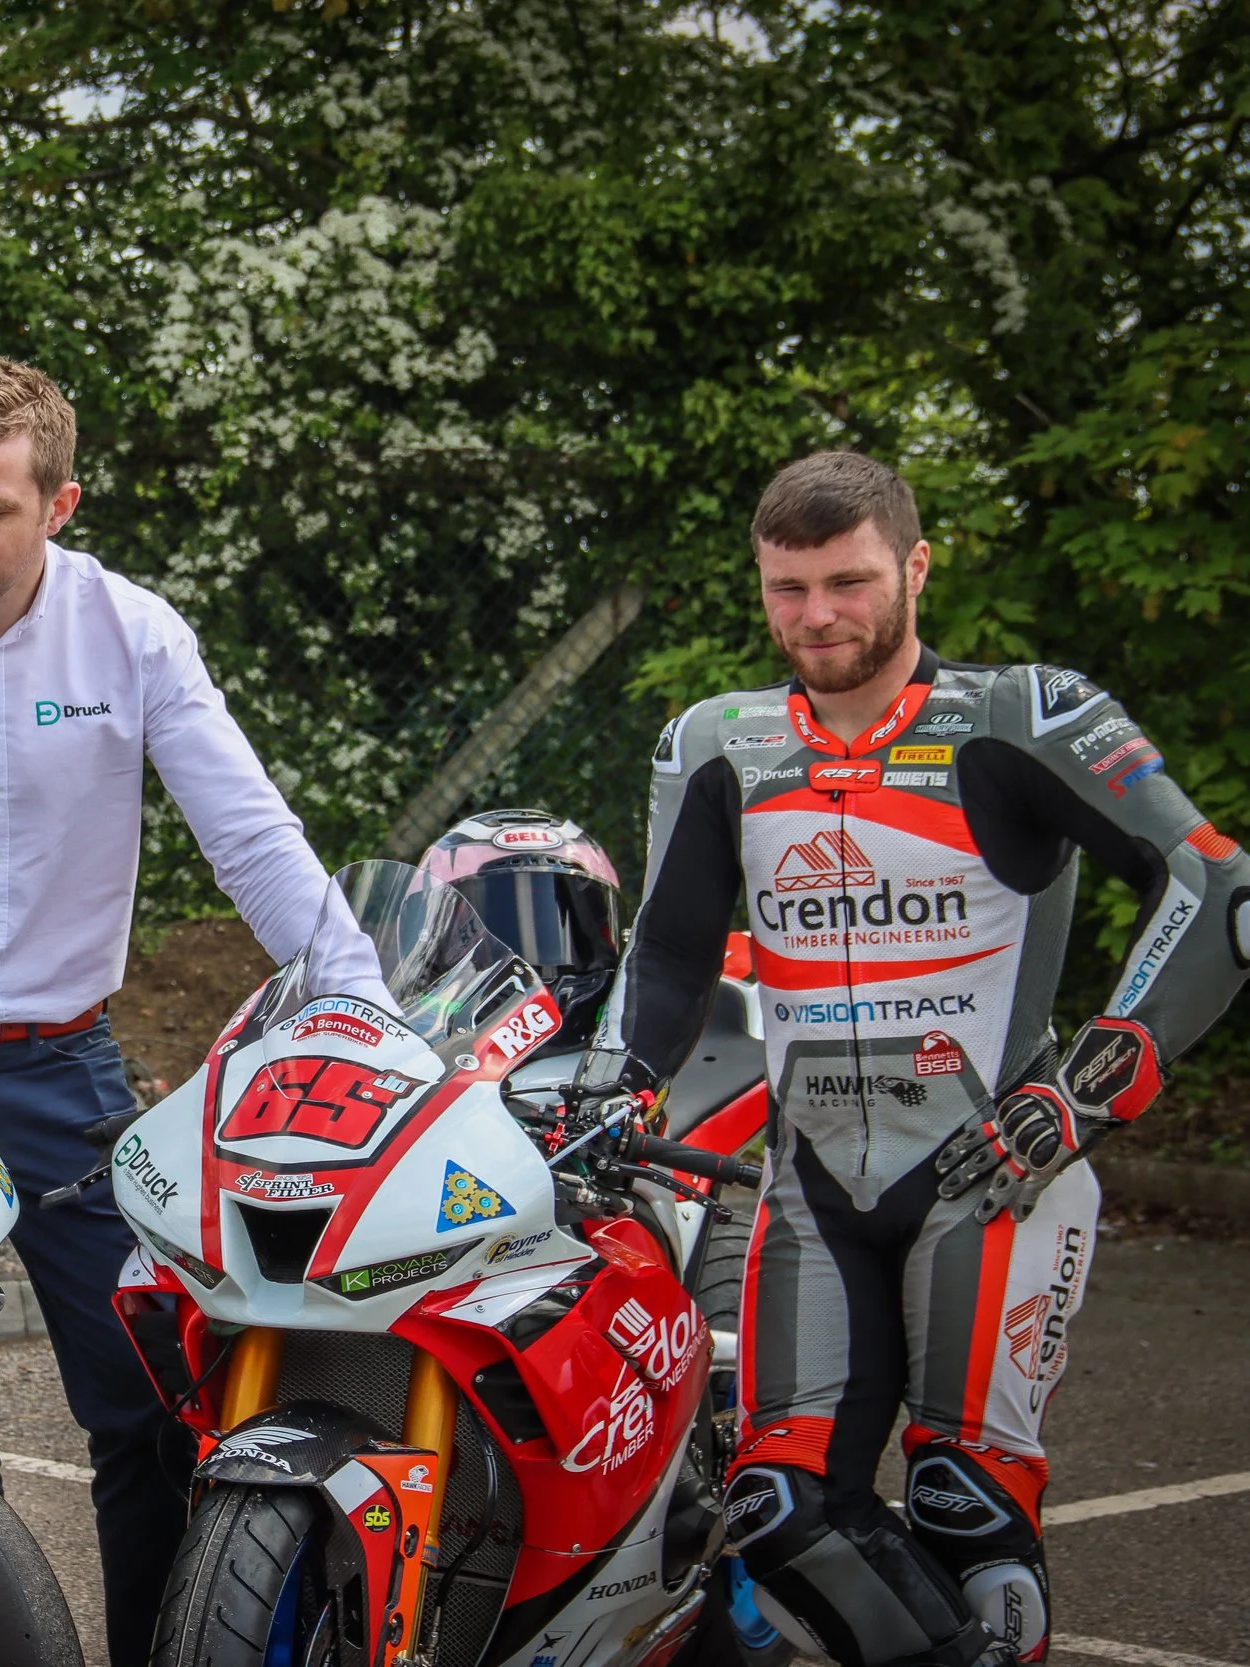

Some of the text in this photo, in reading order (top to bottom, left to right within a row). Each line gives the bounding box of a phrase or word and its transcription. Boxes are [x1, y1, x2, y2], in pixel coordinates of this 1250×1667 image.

[63, 702, 112, 718] Druck
[869, 699, 907, 745] RST
[727, 735, 787, 746] LS2
[796, 711, 828, 745] RST
[895, 749, 946, 761] PIRELLI
[762, 766, 803, 781] Druck
[813, 766, 878, 780] RST
[882, 771, 949, 787] OWENS
[504, 831, 553, 844] BELL
[906, 875, 966, 888] Since 1967
[757, 879, 967, 932] Crendon
[783, 926, 971, 949] TIMBER ENGINEERING
[296, 1000, 411, 1042] VISIONTRACK
[793, 993, 977, 1023] VISIONTRACK
[316, 1018, 378, 1044] Bennetts
[490, 1003, 555, 1060] R&G
[915, 1051, 959, 1062] Bennetts
[917, 1058, 963, 1076] BSB
[1072, 1034, 1123, 1094] RST
[221, 1057, 399, 1148] 65
[128, 1148, 179, 1209] Druck
[254, 1180, 313, 1190] SPRINT
[267, 1183, 334, 1198] FILTER
[144, 1193, 164, 1216] business
[488, 1229, 554, 1265] Paynes
[504, 1247, 537, 1262] Hinckley
[371, 1252, 446, 1276] KOVARA
[372, 1260, 449, 1287] PROJECTS
[1029, 1226, 1081, 1415] Crendon
[208, 1446, 294, 1474] HONDA
[601, 1421, 655, 1476] TIMBER
[724, 1488, 776, 1527] RST
[911, 1485, 985, 1513] RST
[586, 1571, 658, 1601] HONDA
